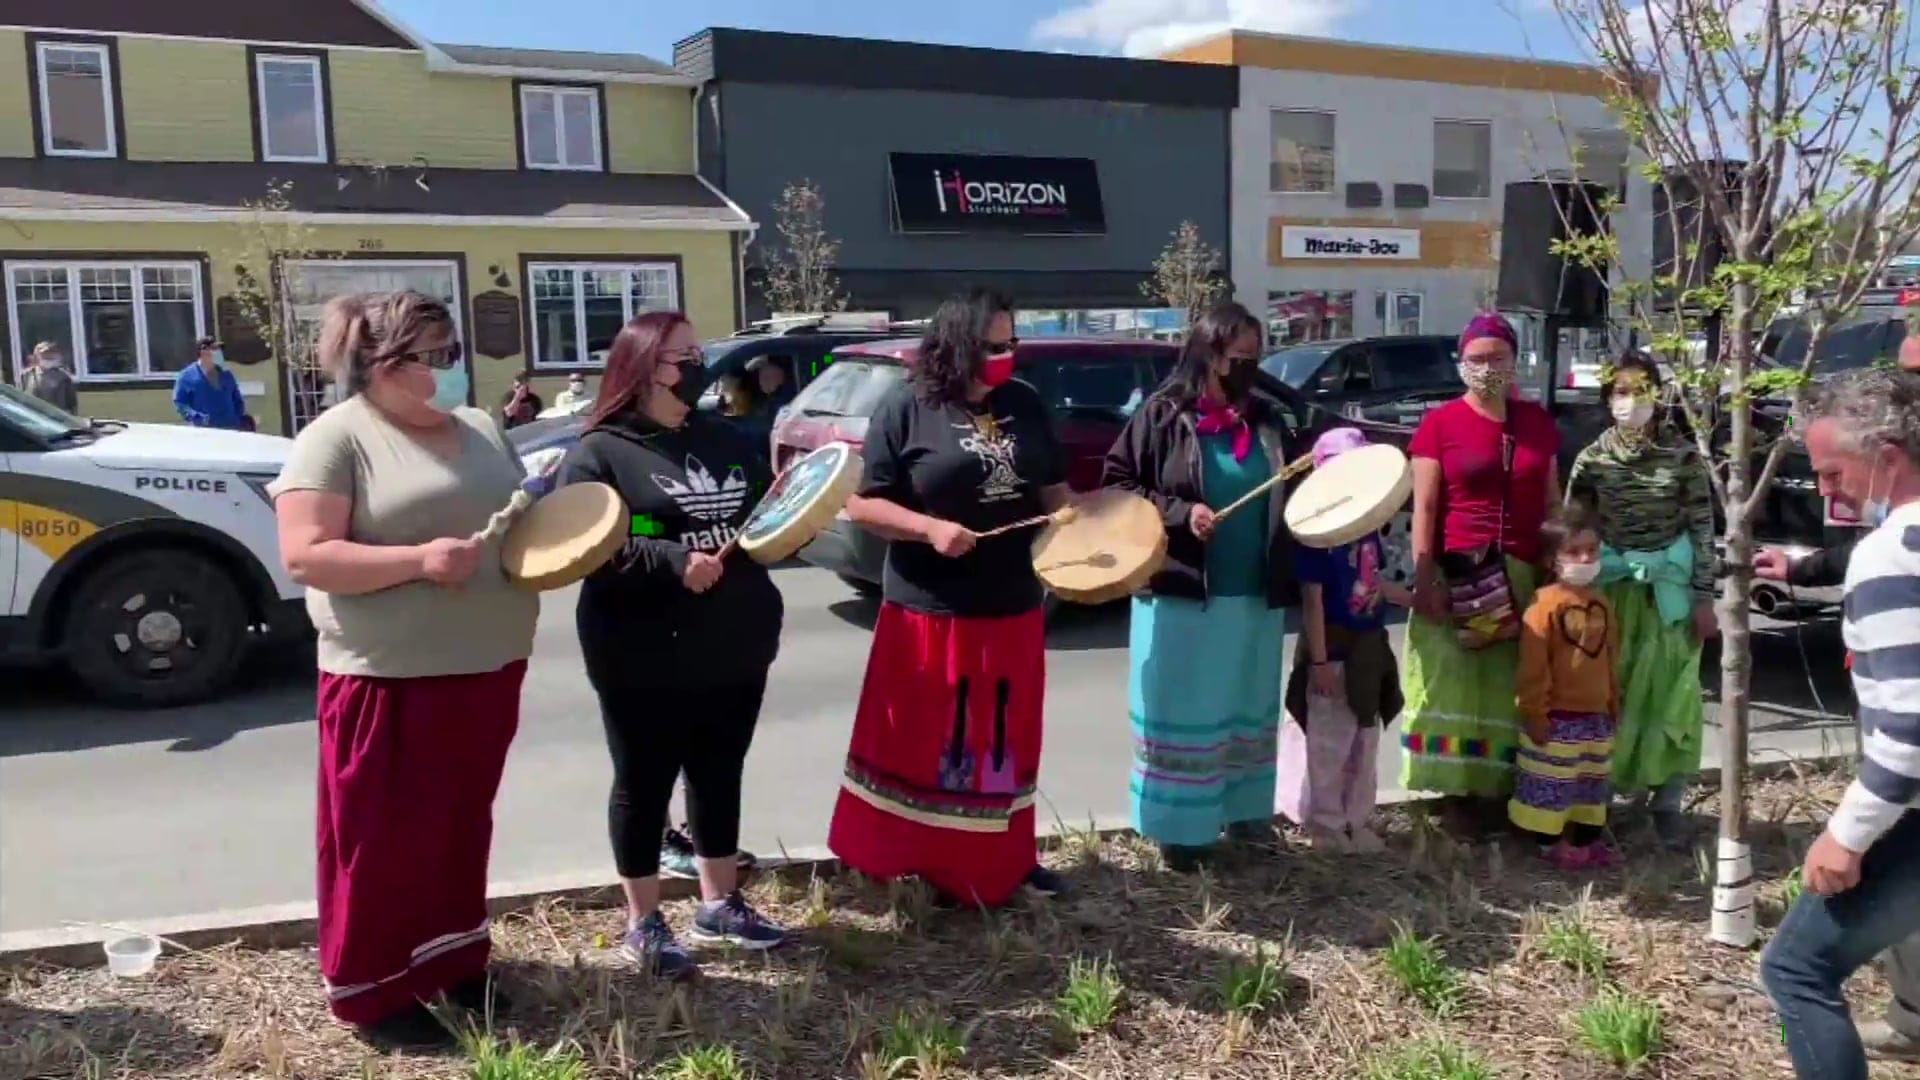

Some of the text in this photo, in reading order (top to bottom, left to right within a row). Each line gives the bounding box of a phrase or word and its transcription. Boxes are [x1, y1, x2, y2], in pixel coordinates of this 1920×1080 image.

[135, 476, 228, 493] POLICE
[21, 519, 81, 537] 8050
[680, 522, 738, 550] nativ
